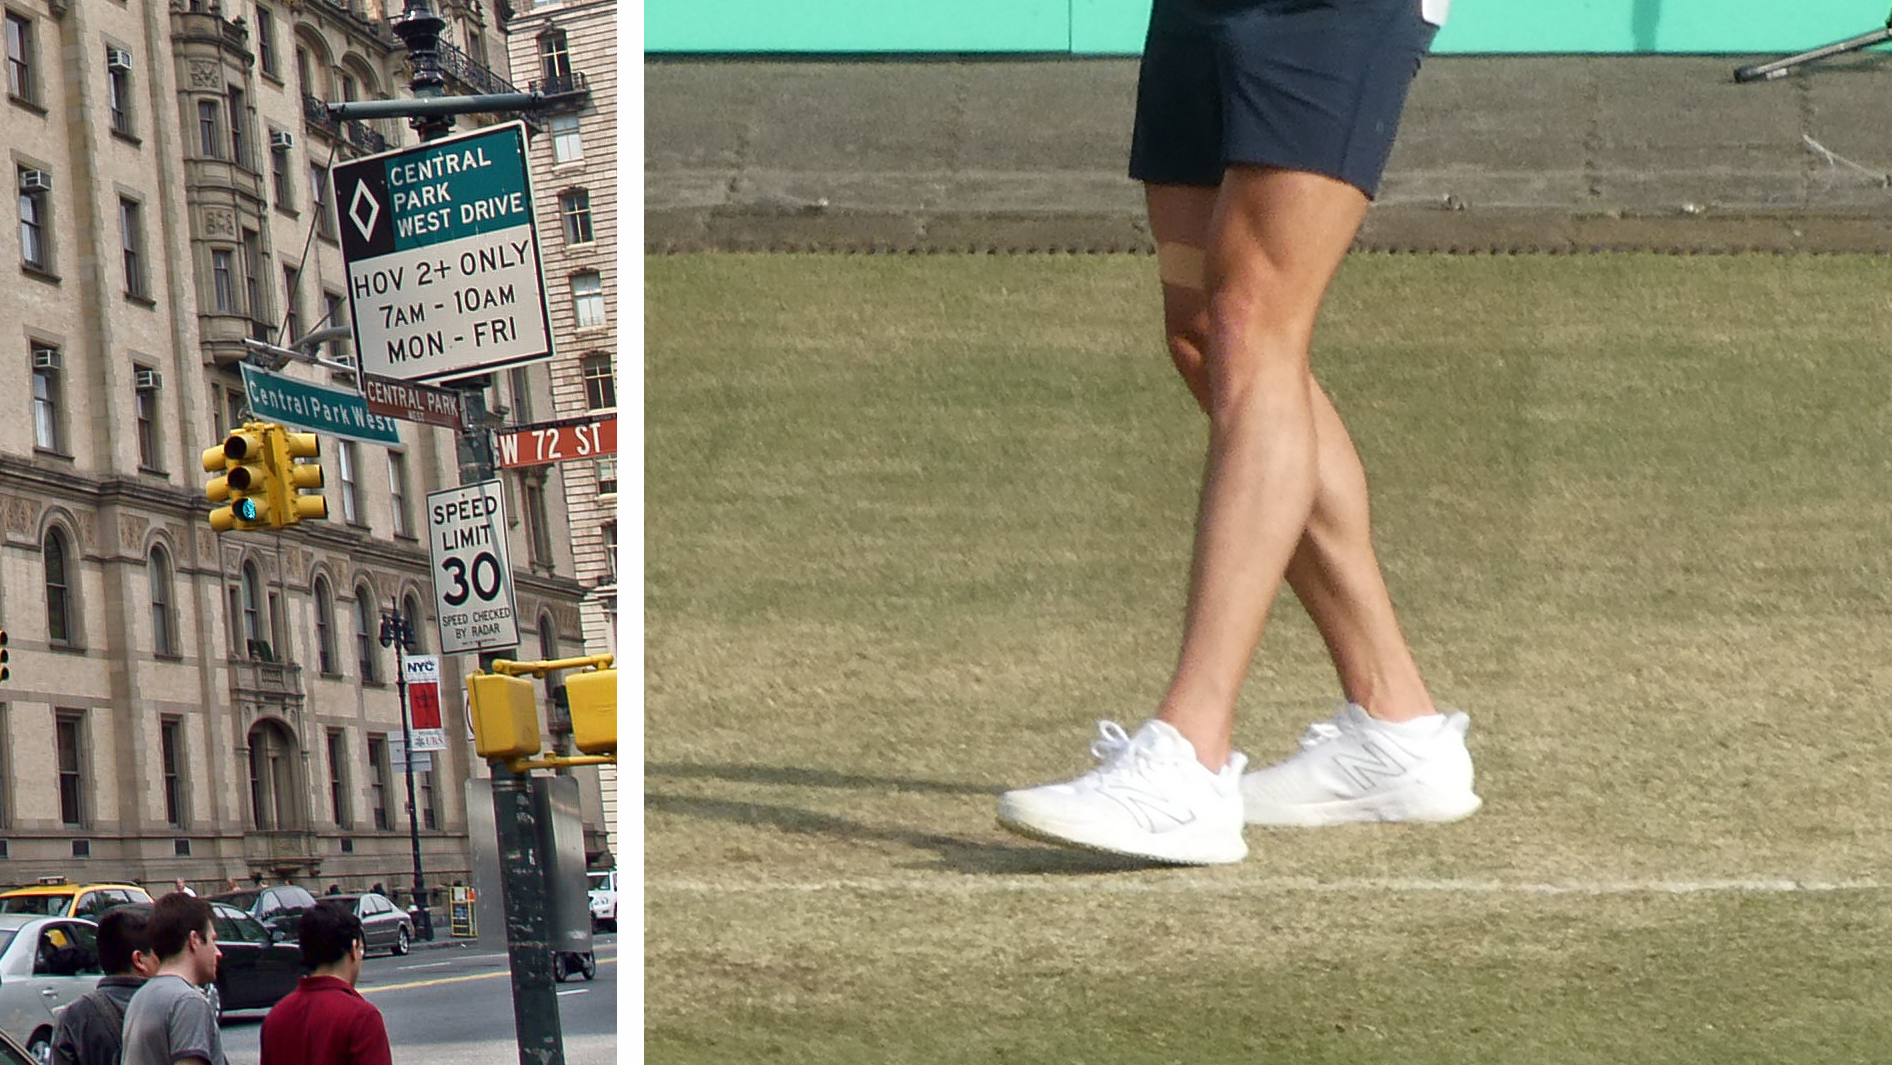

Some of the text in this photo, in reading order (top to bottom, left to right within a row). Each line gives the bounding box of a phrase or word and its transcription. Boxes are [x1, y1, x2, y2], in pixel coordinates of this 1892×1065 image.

[391, 147, 491, 185] CENTRAL
[394, 182, 452, 213] PARK
[397, 192, 524, 239] WEST DRIVE
[354, 239, 529, 299] HOV 2+ ONLY
[379, 302, 425, 329] 7AM
[454, 284, 516, 314] 10AM
[387, 331, 444, 364] MON
[474, 316, 518, 348] FRI
[249, 380, 394, 432] Central Park West
[367, 381, 459, 416] CENTRAL PARK
[499, 422, 601, 465] W 72 ST
[433, 496, 497, 525] SPEED
[443, 524, 491, 552] LIMIT
[441, 551, 501, 607] 30
[442, 607, 510, 627] SPEED CHECKED
[455, 623, 500, 639] BY RADAR
[407, 661, 434, 673] NYC
